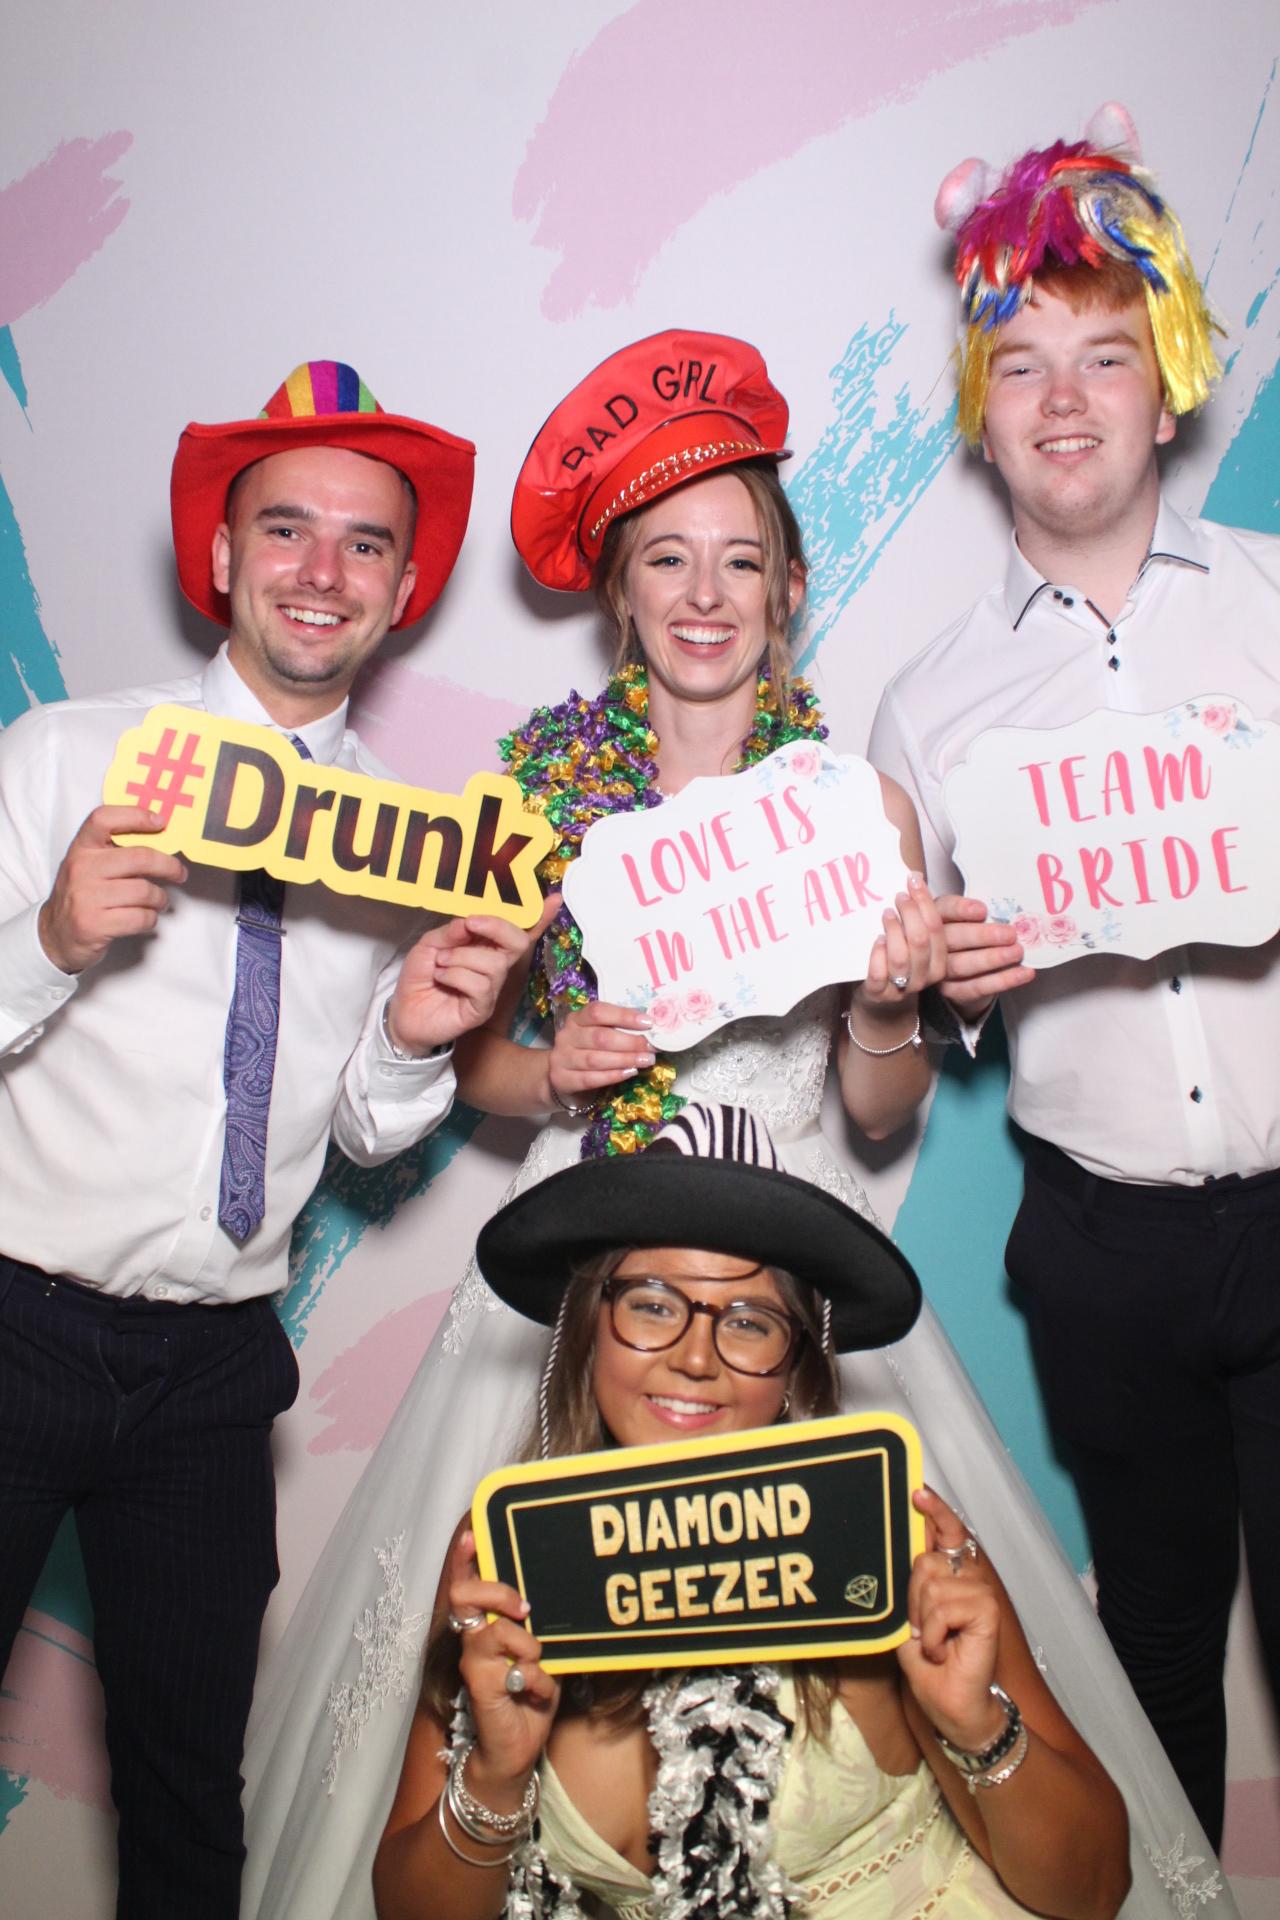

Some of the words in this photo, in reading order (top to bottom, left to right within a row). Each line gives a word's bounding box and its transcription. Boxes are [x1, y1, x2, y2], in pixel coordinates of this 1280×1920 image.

[125, 728, 534, 907] #Drunk
[1018, 744, 1212, 827] TEAM
[621, 811, 749, 907] LOVE
[754, 785, 816, 854] IS
[1036, 826, 1248, 915] BRIDE
[703, 884, 789, 961] THE
[803, 852, 884, 927] AIR
[590, 1483, 811, 1557] DIAMOND
[605, 1552, 817, 1626] GEEZER
